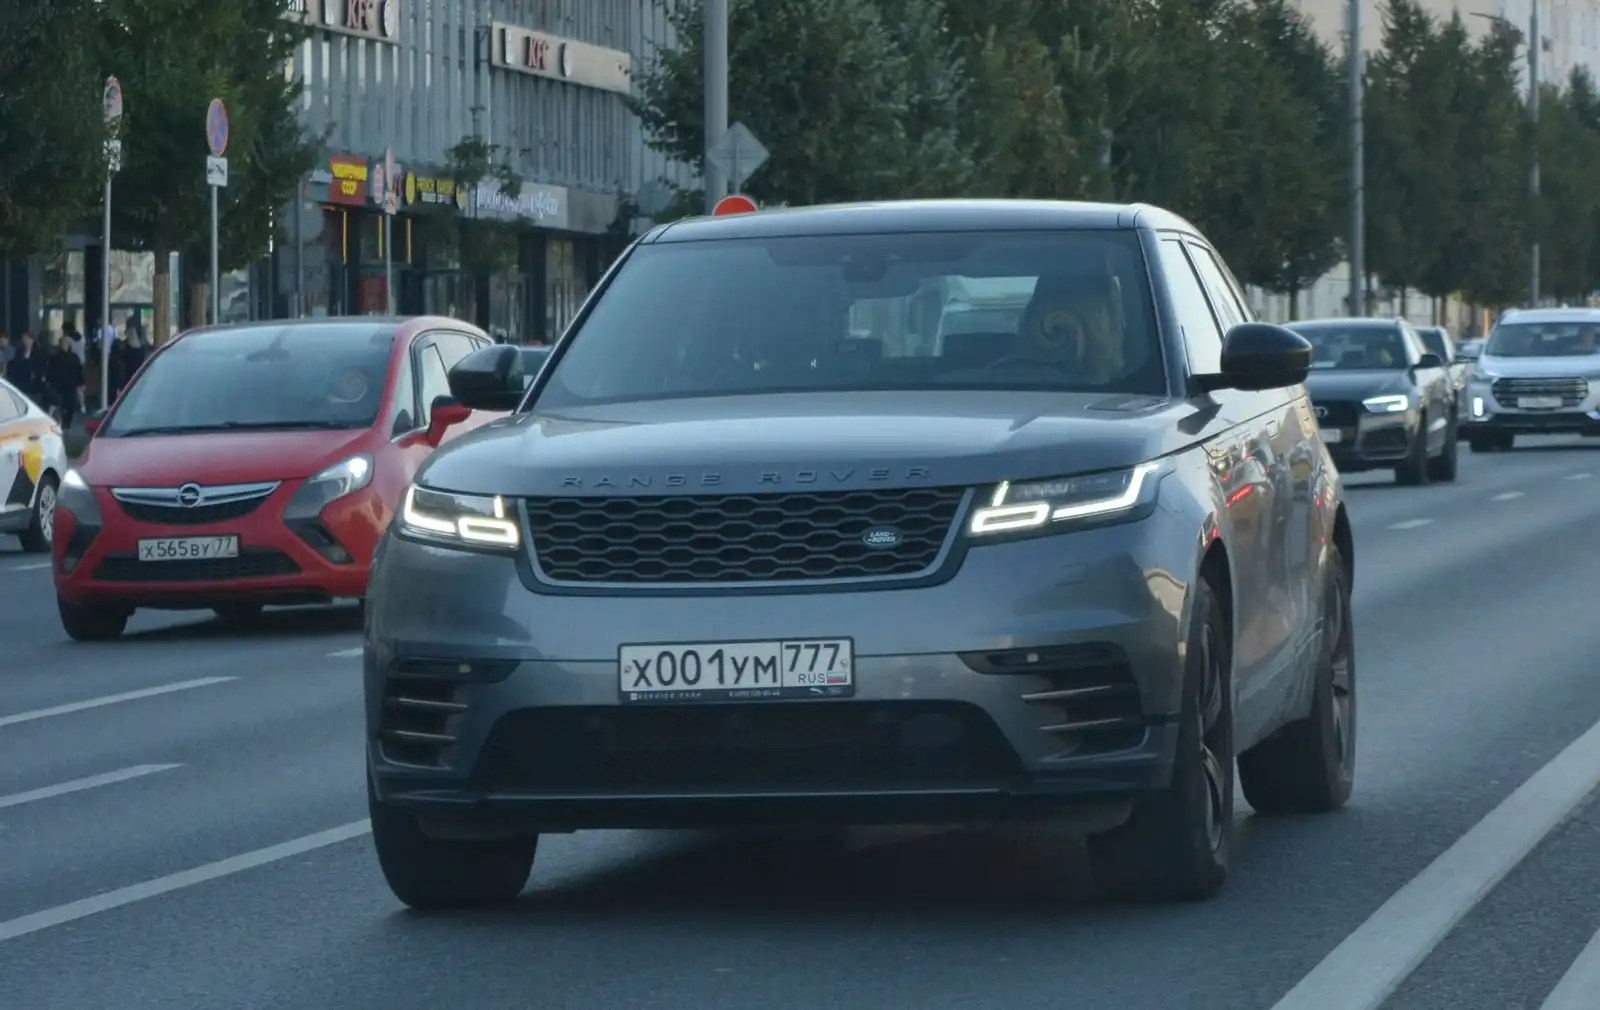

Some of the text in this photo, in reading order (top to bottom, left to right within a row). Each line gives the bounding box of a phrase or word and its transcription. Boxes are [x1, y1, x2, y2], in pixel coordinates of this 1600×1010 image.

[530, 37, 549, 70] KFC
[562, 466, 929, 488] RANGE ROVER
[216, 538, 231, 554] 77
[784, 643, 841, 673] 777
[798, 673, 826, 684] RUS
